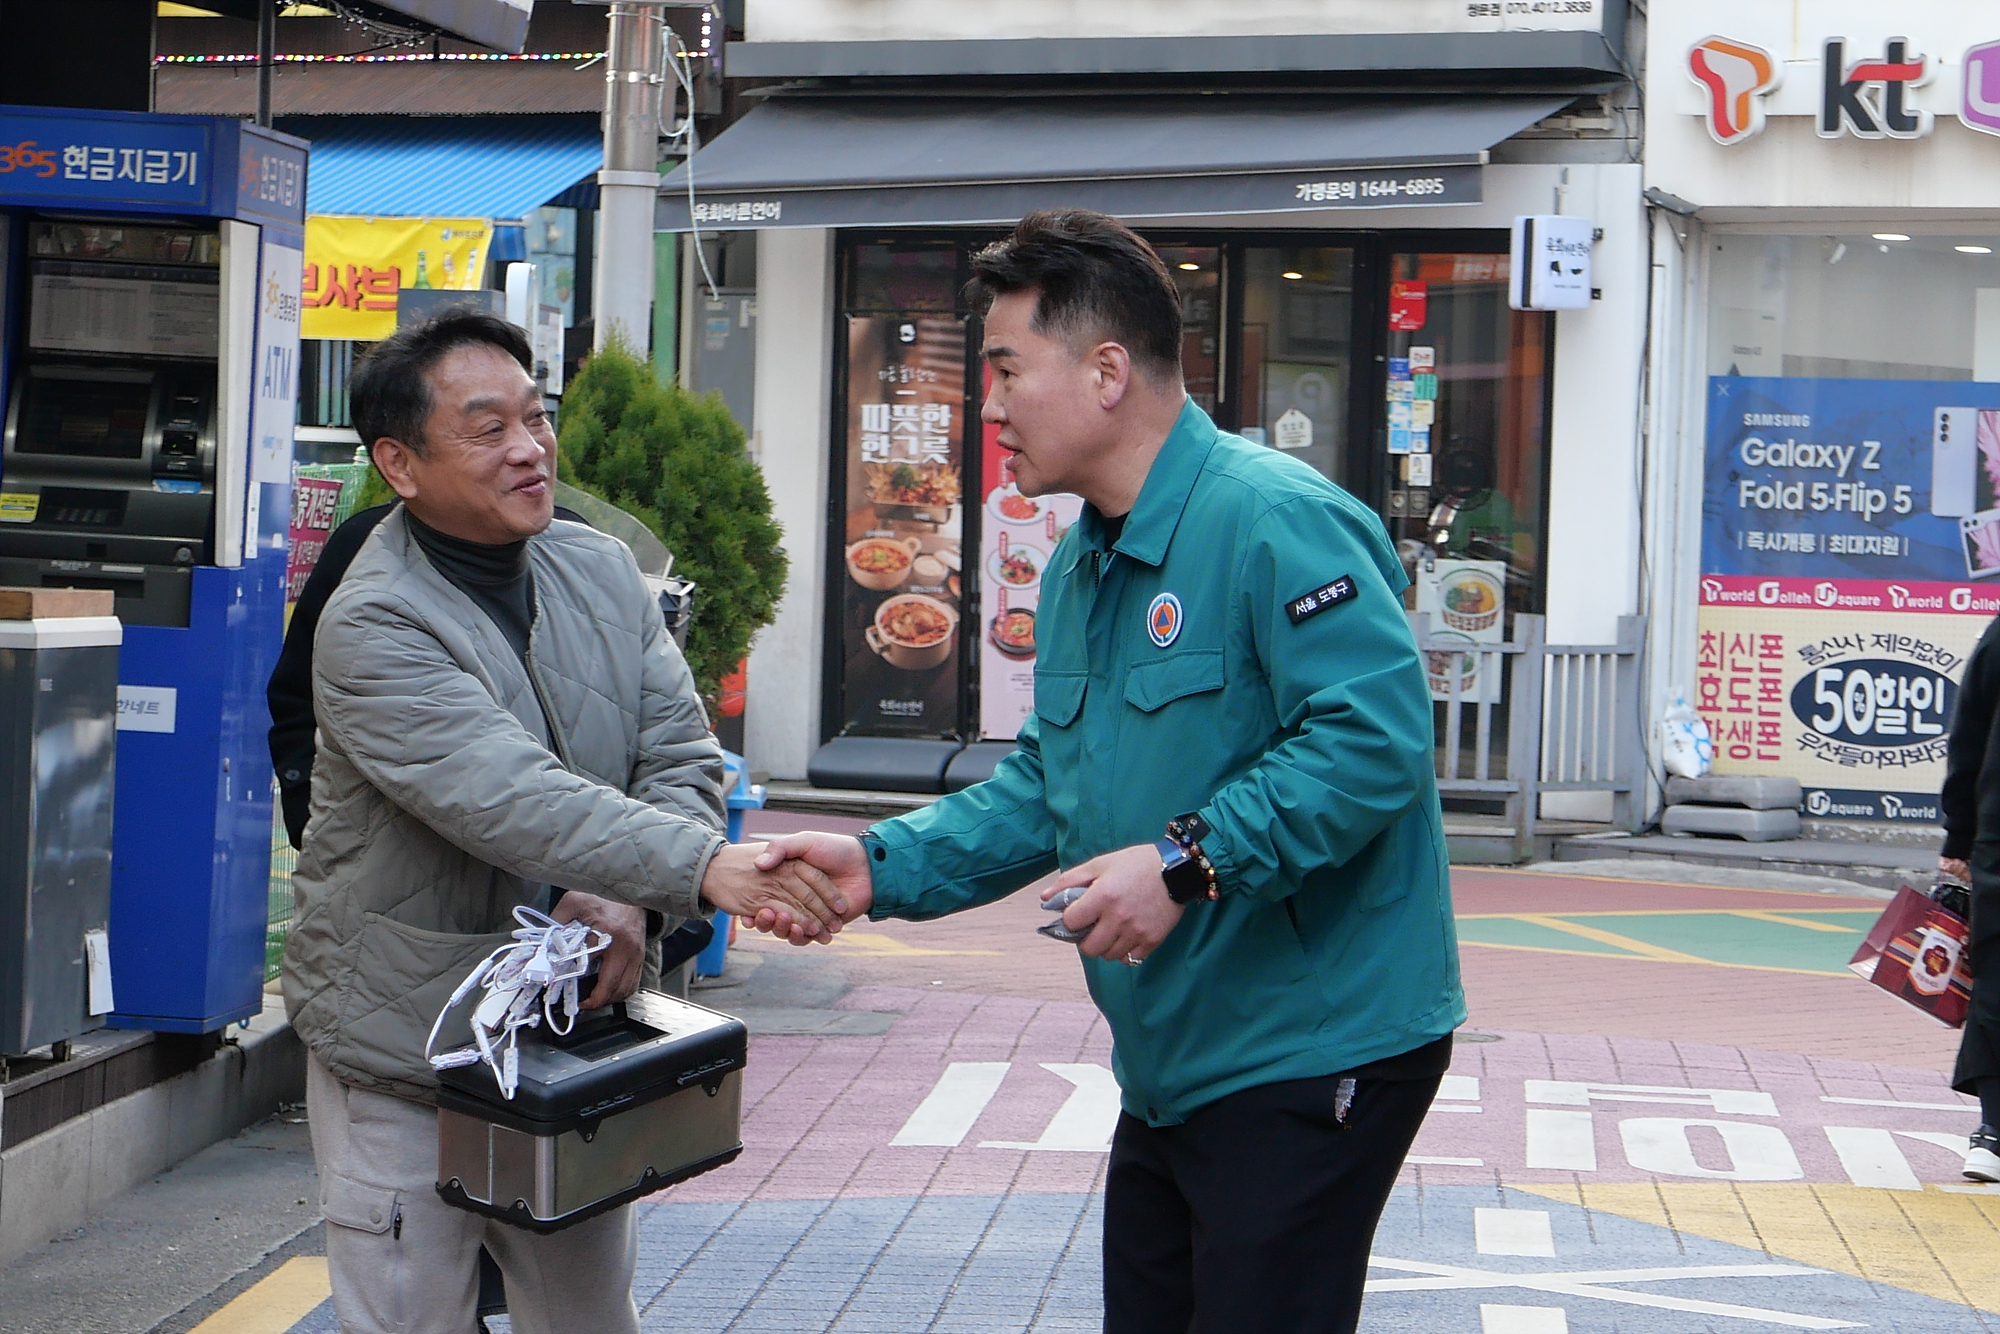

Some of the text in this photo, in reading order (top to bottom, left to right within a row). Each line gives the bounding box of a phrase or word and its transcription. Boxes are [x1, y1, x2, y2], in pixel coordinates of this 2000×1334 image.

[1822, 42, 1923, 132] kt
[63, 145, 198, 186] 현금지급기
[1295, 178, 1445, 201] 가맹문의 1644-6895
[262, 345, 292, 401] ATM
[861, 403, 952, 434] 따뜻한
[1743, 413, 1811, 428] SAMSUNG
[861, 433, 951, 464] 한그릇
[1741, 437, 1881, 478] Galaxy Z
[1739, 480, 1804, 510] Fold
[1893, 485, 1912, 514] 5
[1747, 531, 1899, 556] 즉시개통 최대지원
[1295, 581, 1349, 616] 서울 도봉구
[1698, 630, 1784, 673] 최신폰
[1797, 633, 1963, 673] 통신사 제약없이
[1696, 673, 1783, 717] 효도폰
